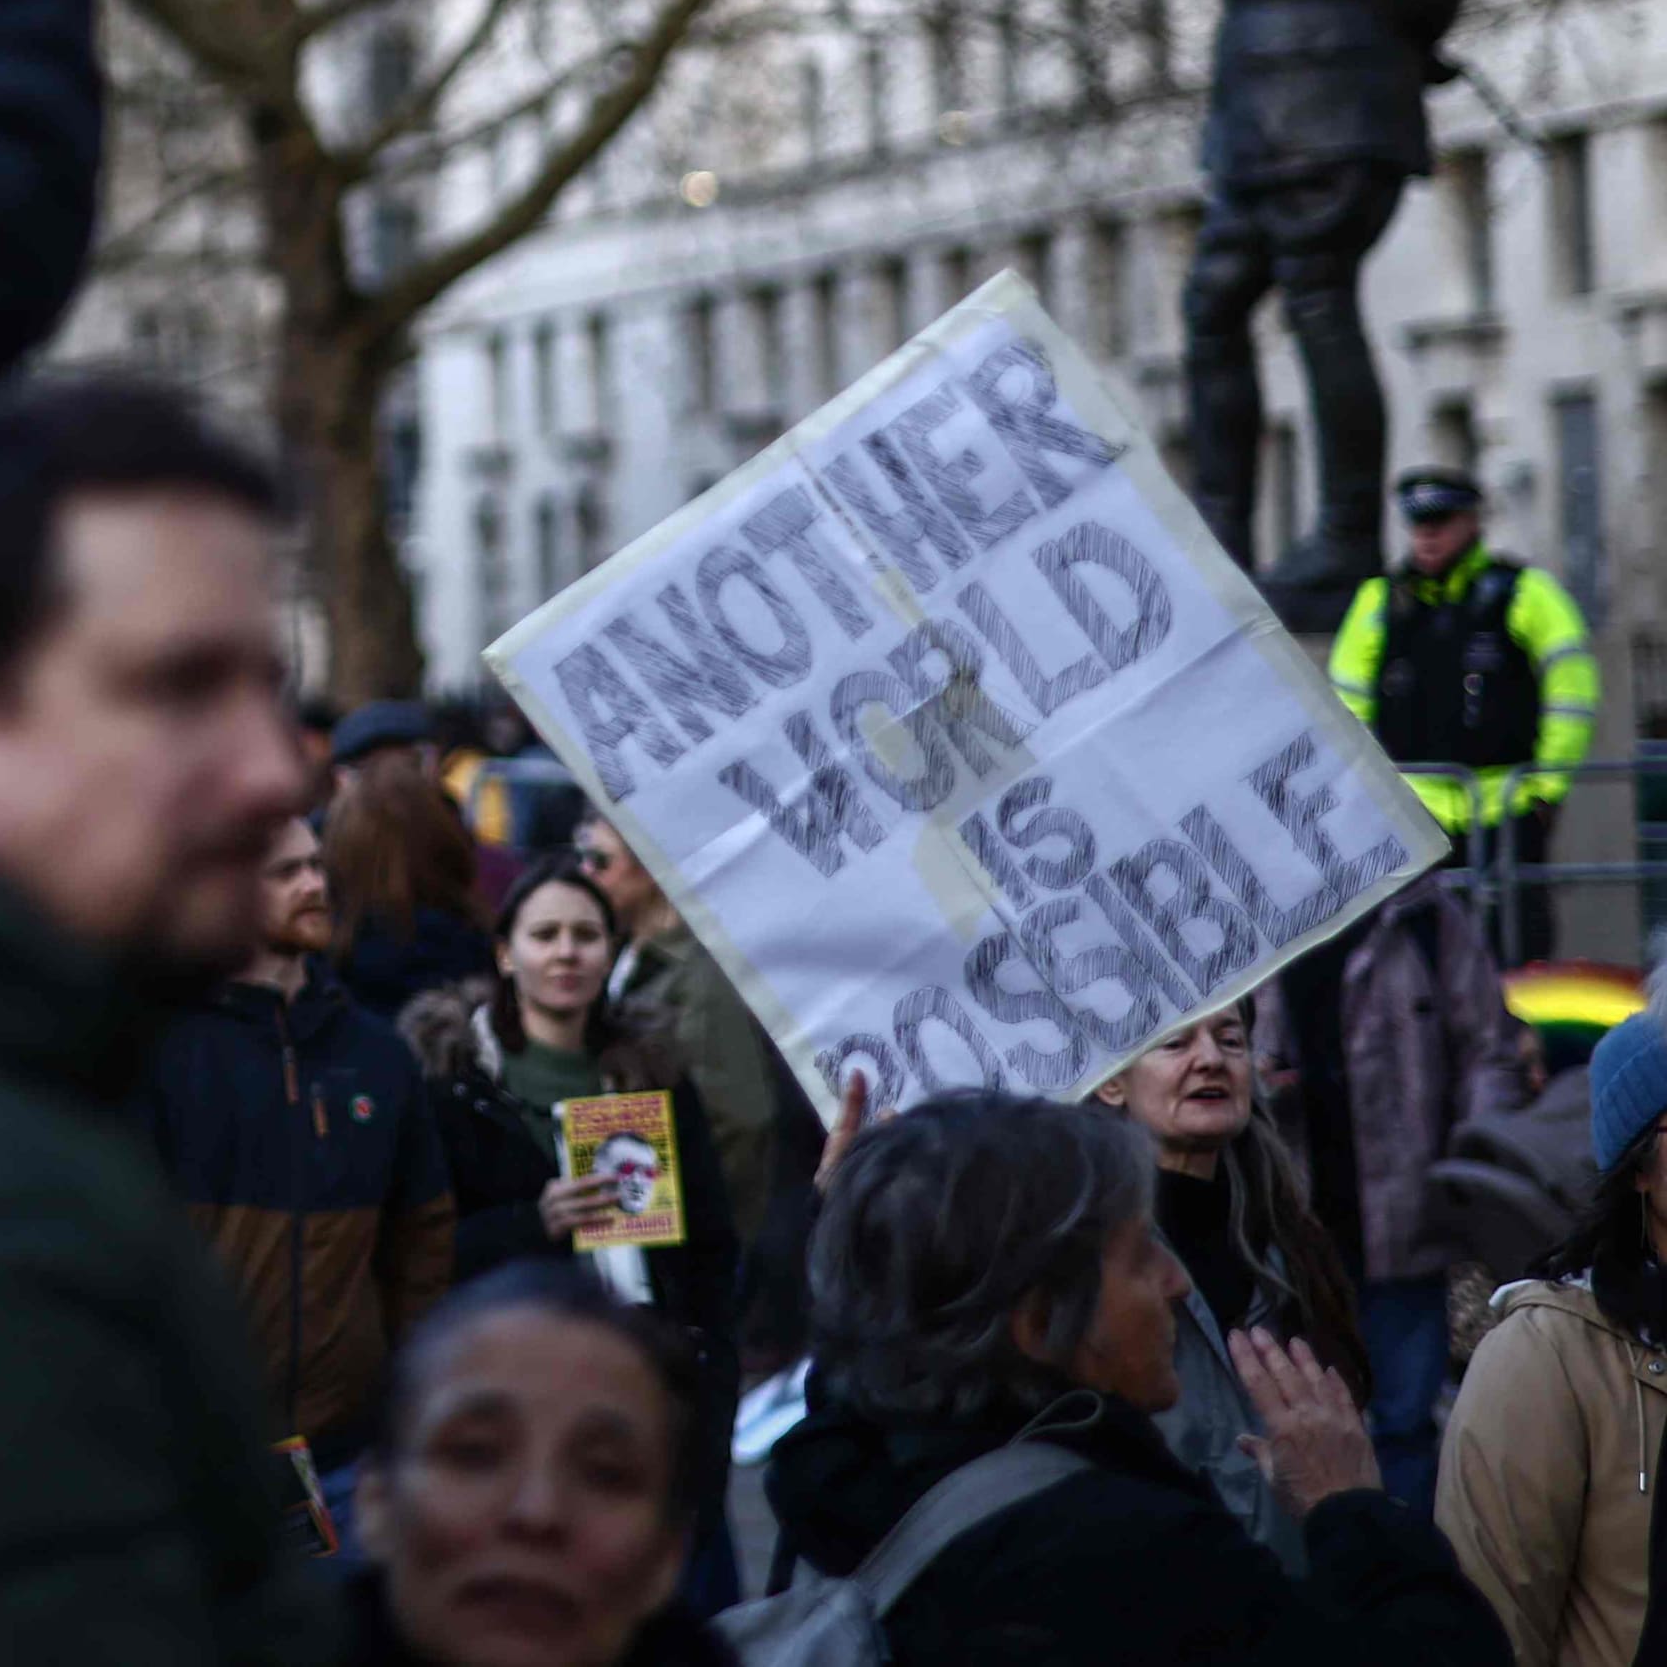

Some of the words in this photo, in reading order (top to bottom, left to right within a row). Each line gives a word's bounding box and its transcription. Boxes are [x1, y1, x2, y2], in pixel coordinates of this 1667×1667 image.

[553, 338, 1129, 804] ANOTHER
[719, 519, 1172, 877] WORLD
[959, 776, 1097, 912] IS
